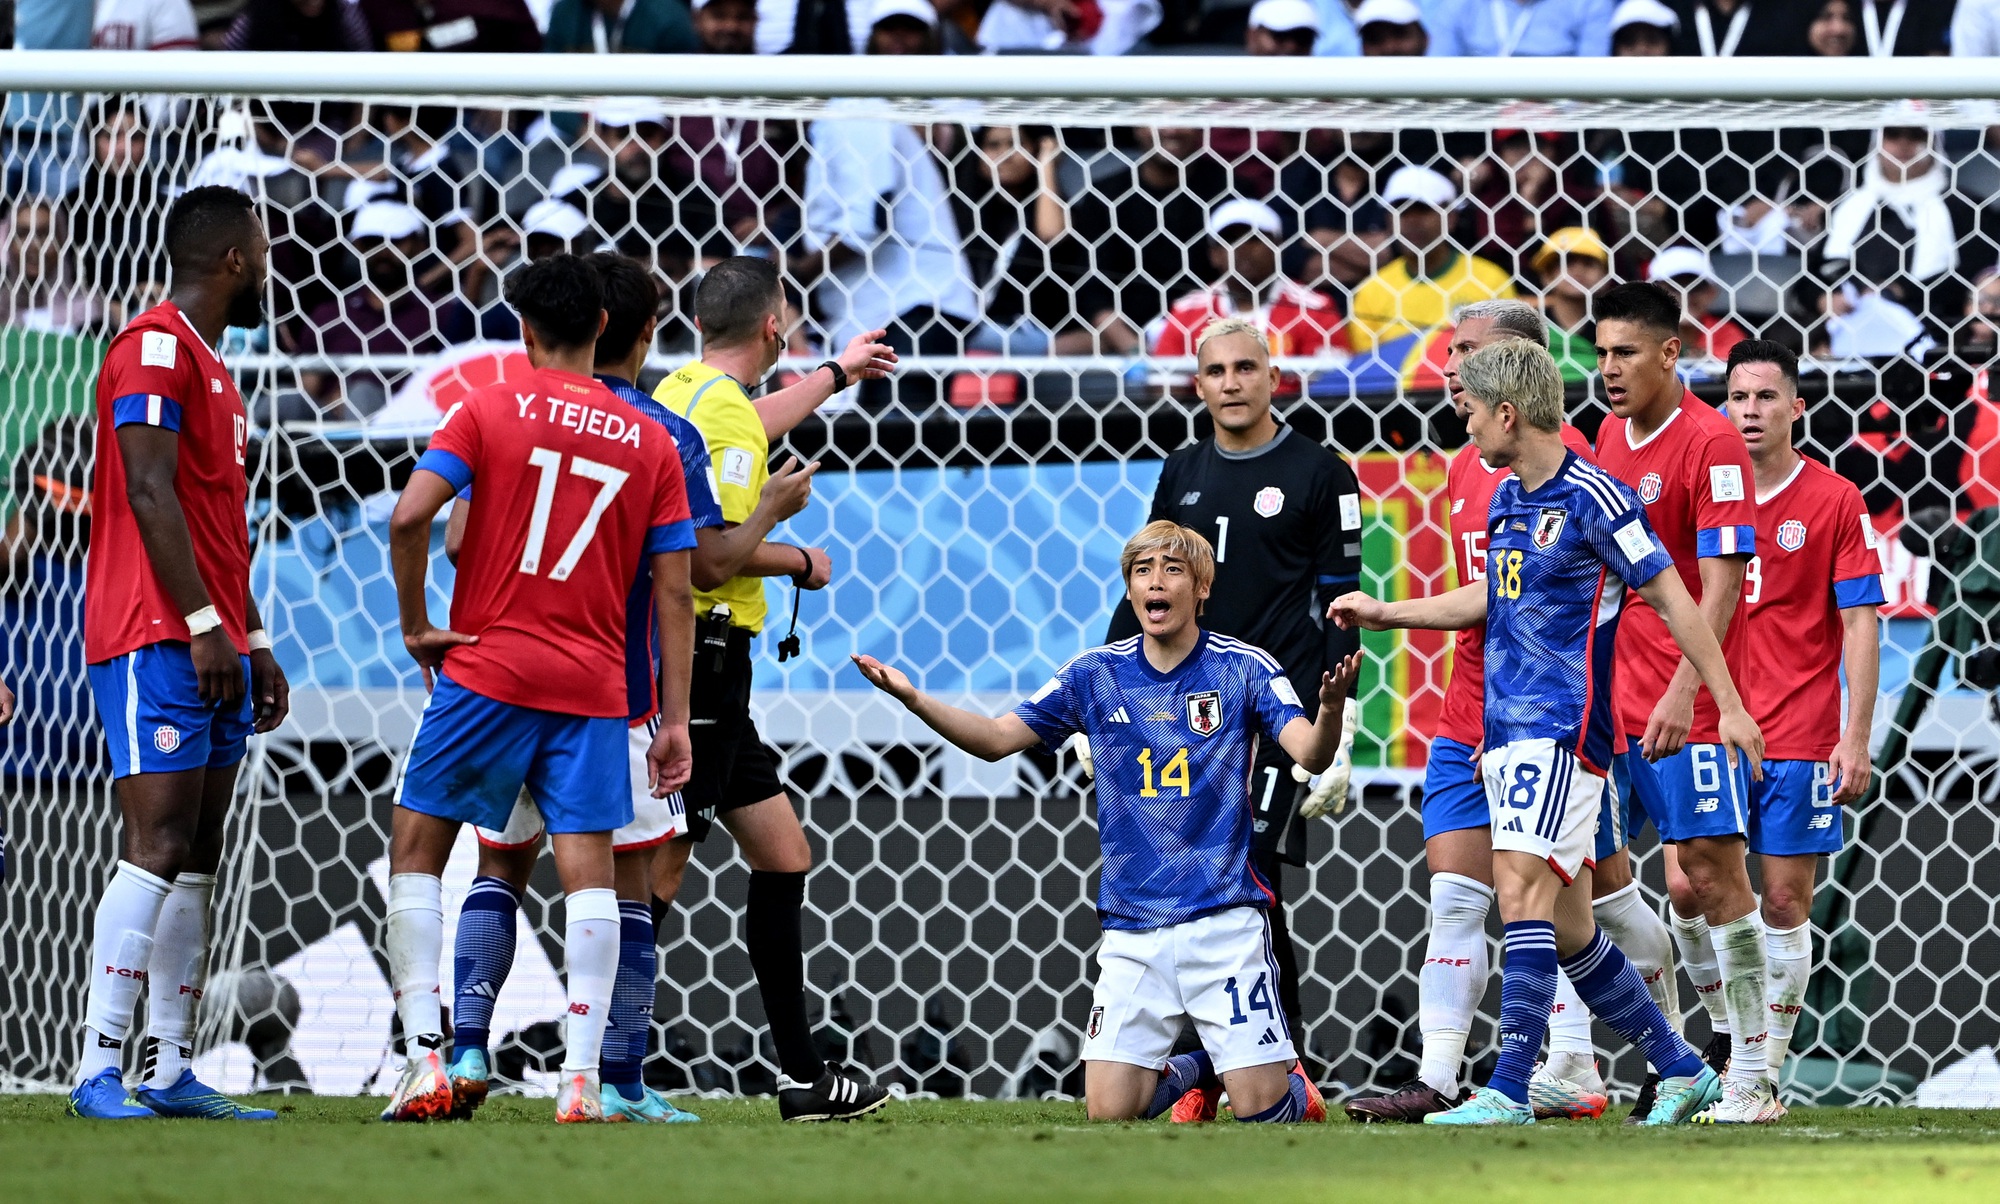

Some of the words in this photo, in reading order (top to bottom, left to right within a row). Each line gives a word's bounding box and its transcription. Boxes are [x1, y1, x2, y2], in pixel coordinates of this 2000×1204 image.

[563, 383, 590, 395] FCRF
[515, 393, 537, 418] Y.
[547, 396, 640, 449] TEJEDA
[519, 446, 631, 582] 17
[1784, 526, 1800, 546] CR
[1215, 516, 1229, 563] 1
[1461, 531, 1488, 581] 15
[1495, 549, 1523, 600] 18
[160, 731, 174, 748] CR
[1136, 748, 1190, 798] 14
[1260, 766, 1279, 812] 1
[1691, 744, 1720, 792] 6
[1811, 761, 1833, 808] 8
[1224, 972, 1275, 1026] 14
